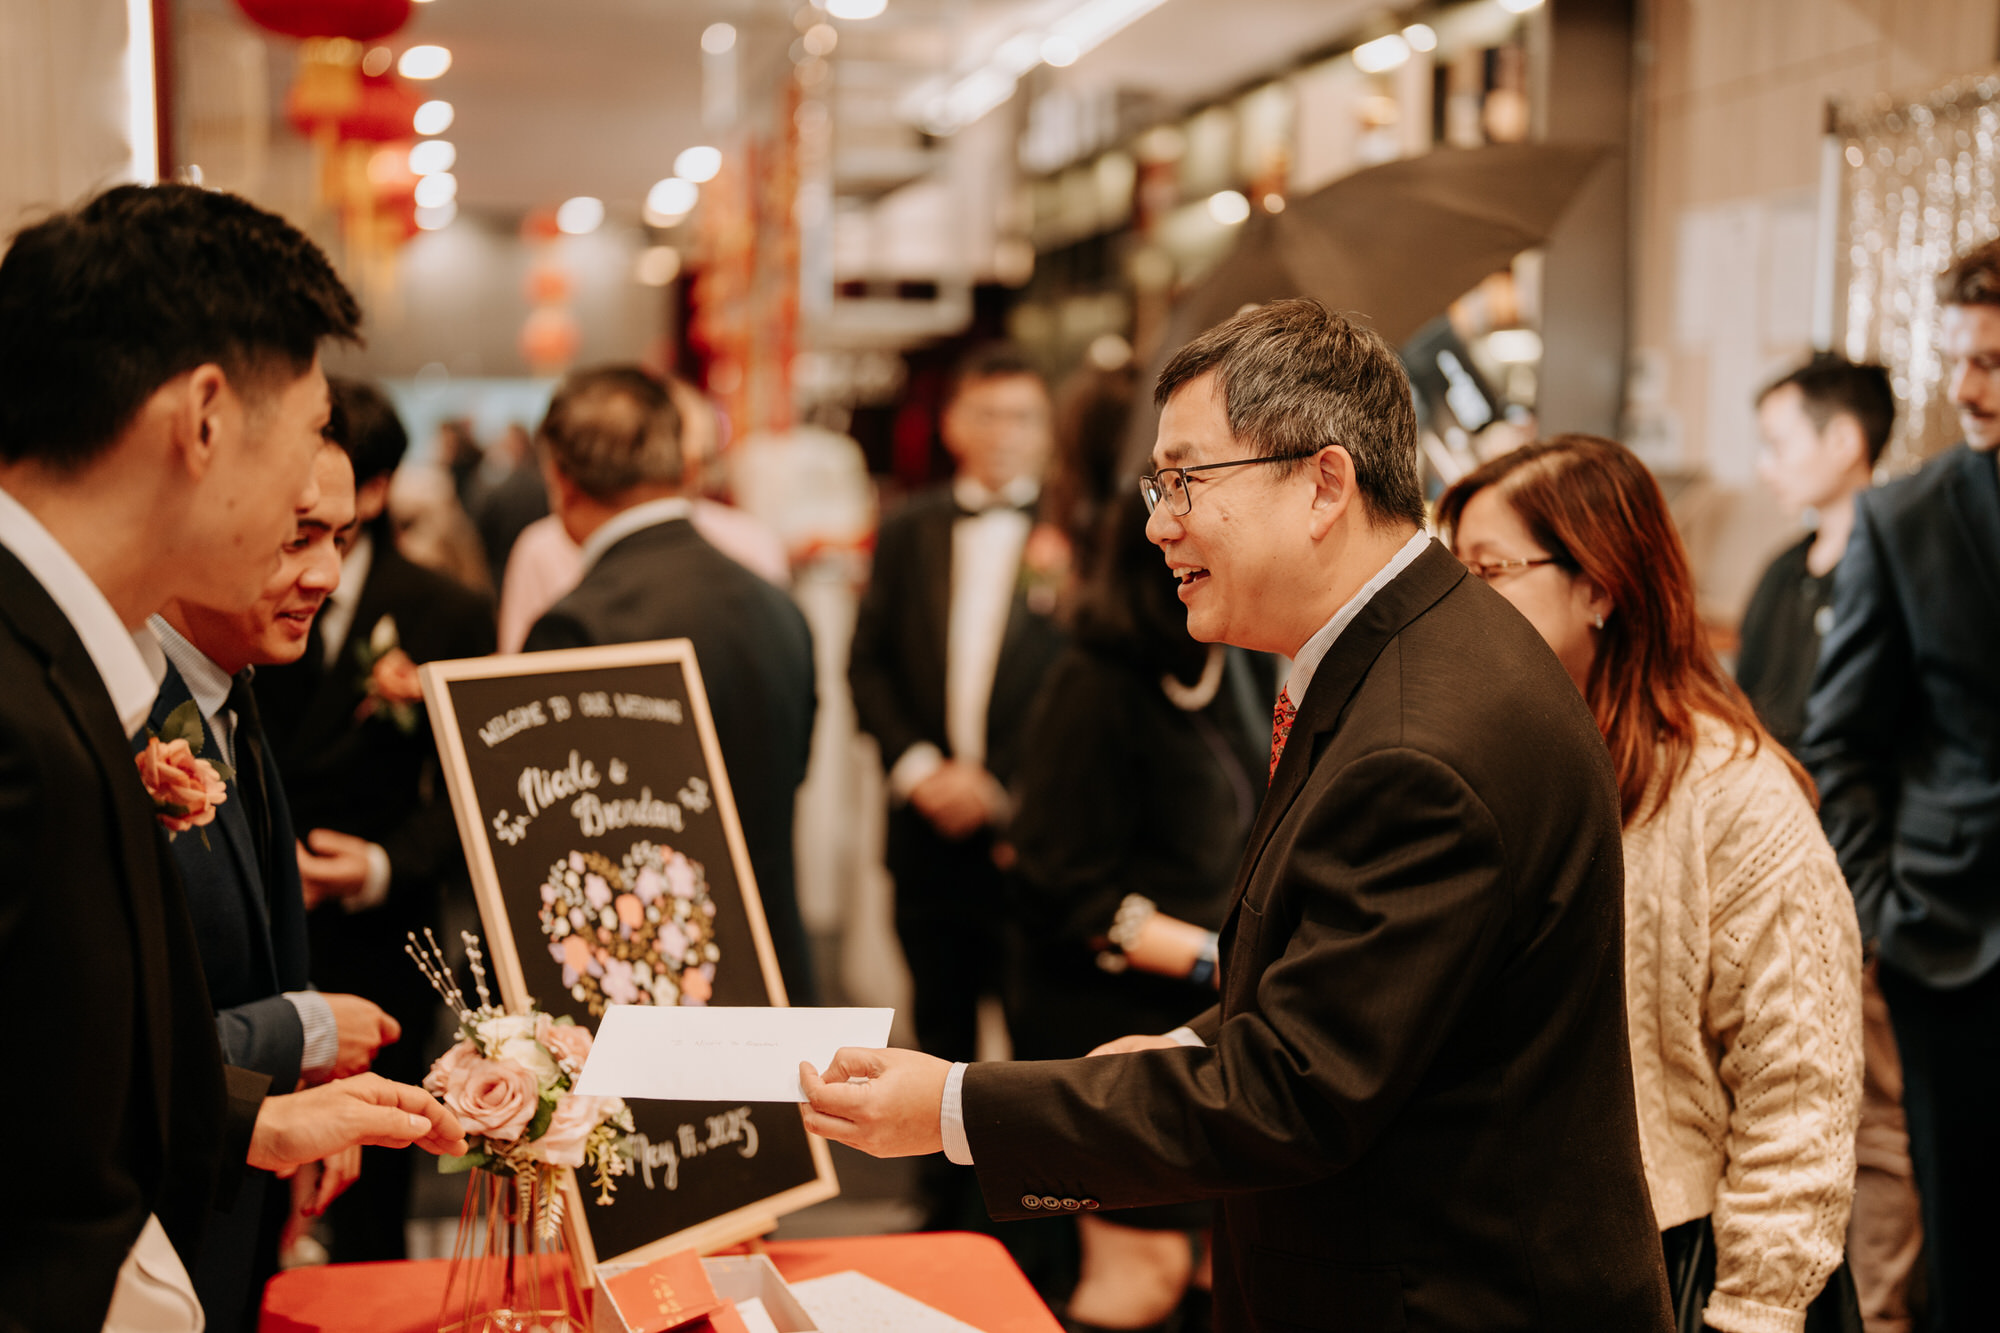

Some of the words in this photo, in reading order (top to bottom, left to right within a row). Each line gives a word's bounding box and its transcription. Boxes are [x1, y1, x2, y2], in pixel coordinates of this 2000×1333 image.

[478, 700, 548, 748] WELCOME
[547, 695, 572, 722] TO
[578, 691, 614, 718] OUR
[613, 692, 683, 725] WEDDING
[518, 749, 600, 818] Nicole
[571, 785, 685, 837] Brendan
